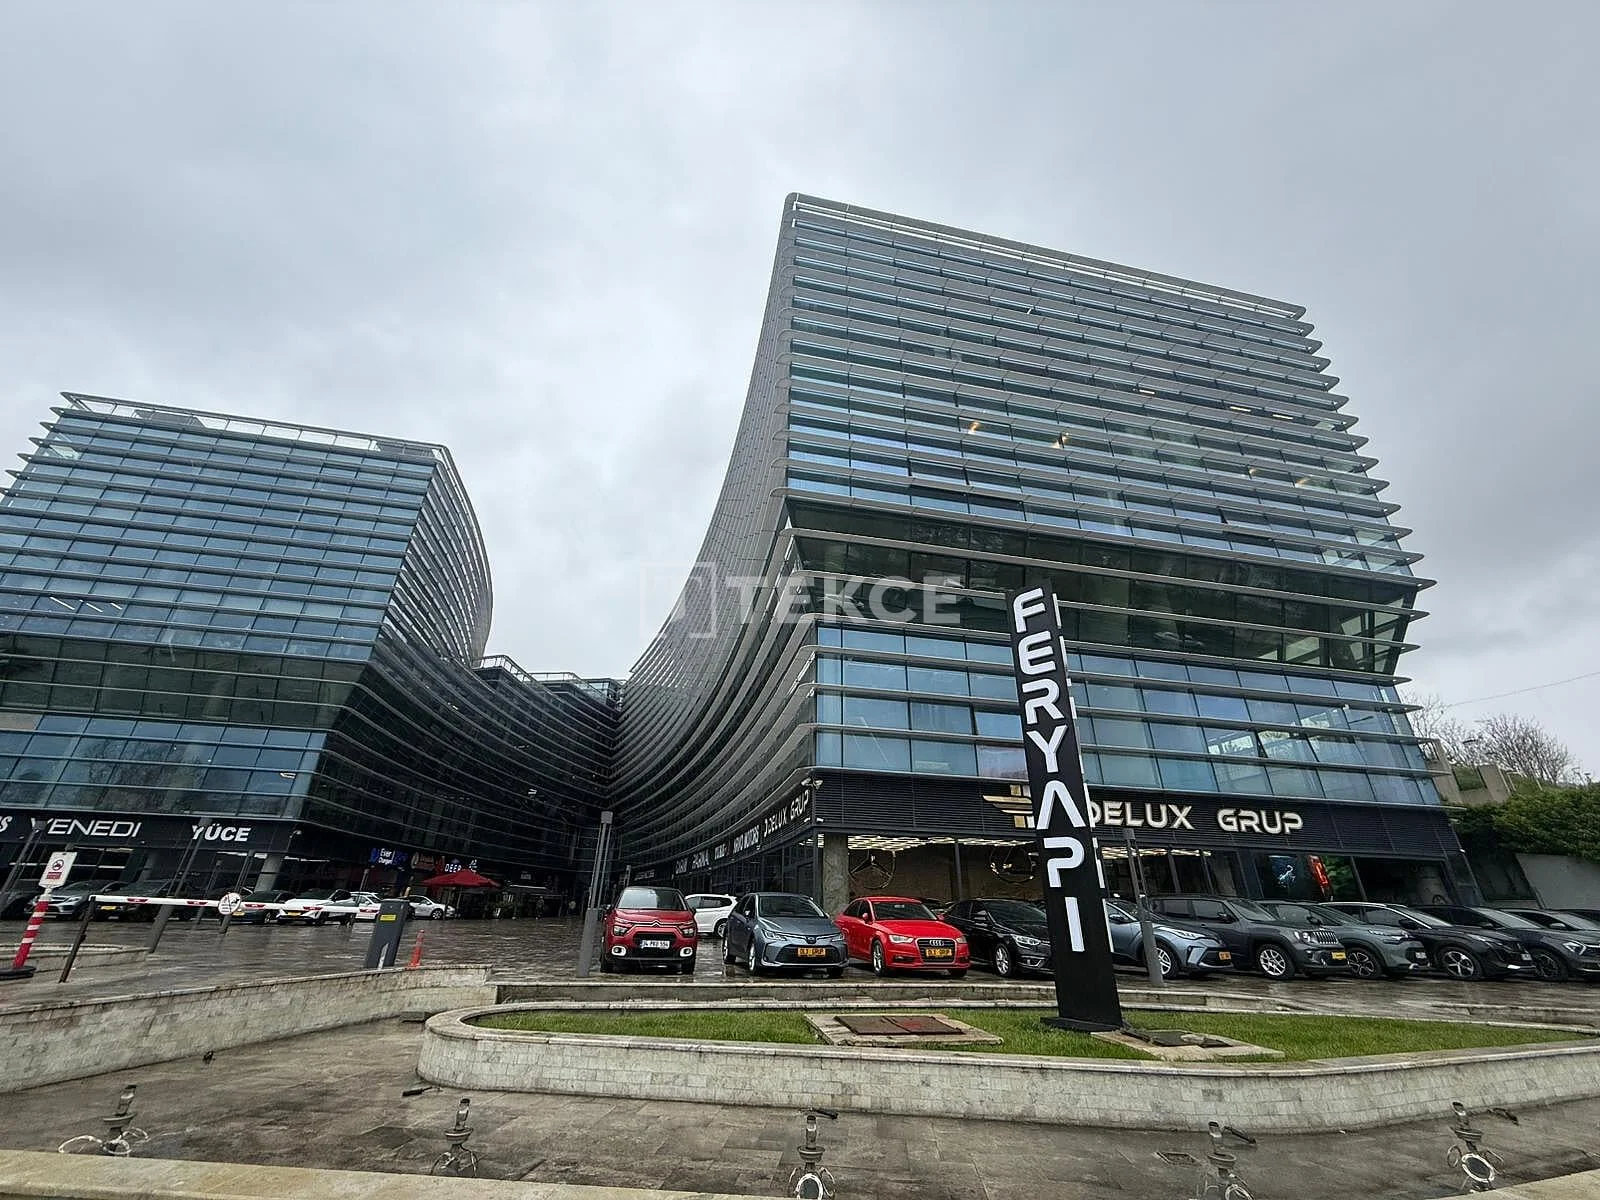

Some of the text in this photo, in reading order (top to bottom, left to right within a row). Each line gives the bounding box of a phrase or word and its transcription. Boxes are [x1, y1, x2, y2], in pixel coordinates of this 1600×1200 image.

[790, 789, 809, 820] GRUP
[191, 823, 252, 842] YÜCE
[1216, 808, 1304, 835] GRUP
